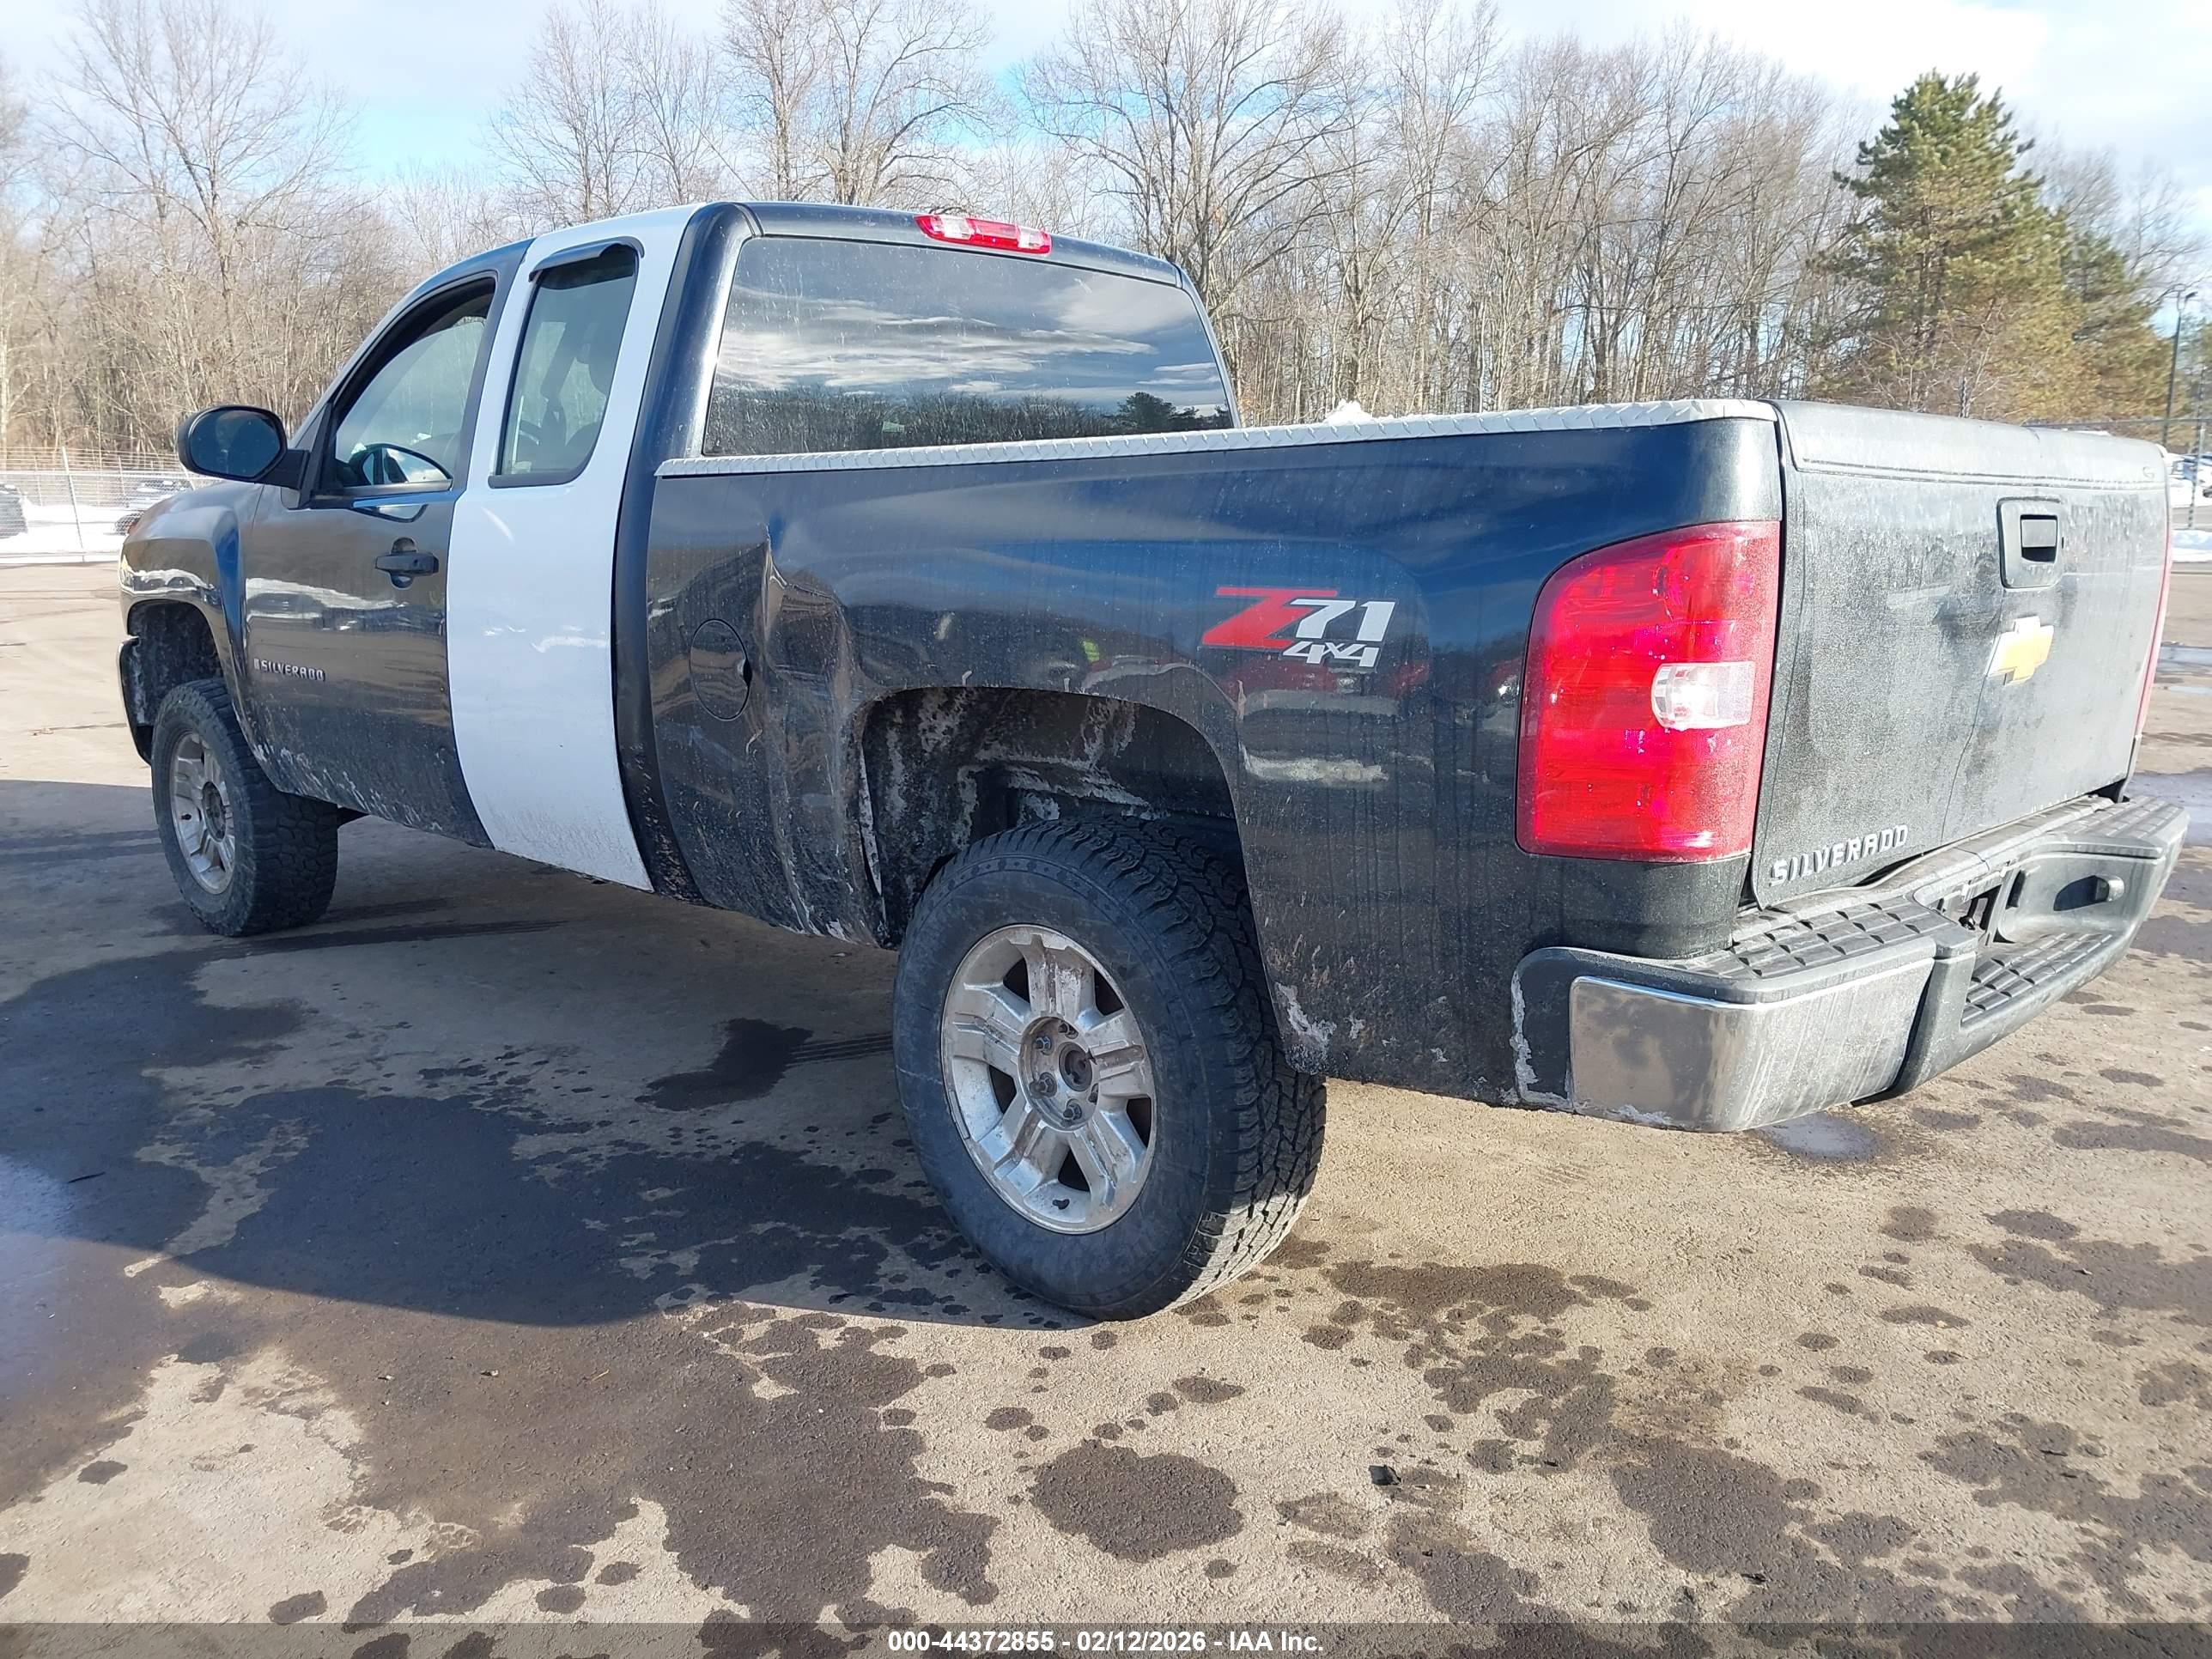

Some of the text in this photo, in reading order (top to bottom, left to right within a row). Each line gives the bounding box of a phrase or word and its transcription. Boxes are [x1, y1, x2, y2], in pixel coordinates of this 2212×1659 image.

[1201, 586, 1396, 650] Z71
[260, 659, 325, 681] SILVERADO
[1769, 824, 1909, 887] SILVERADO
